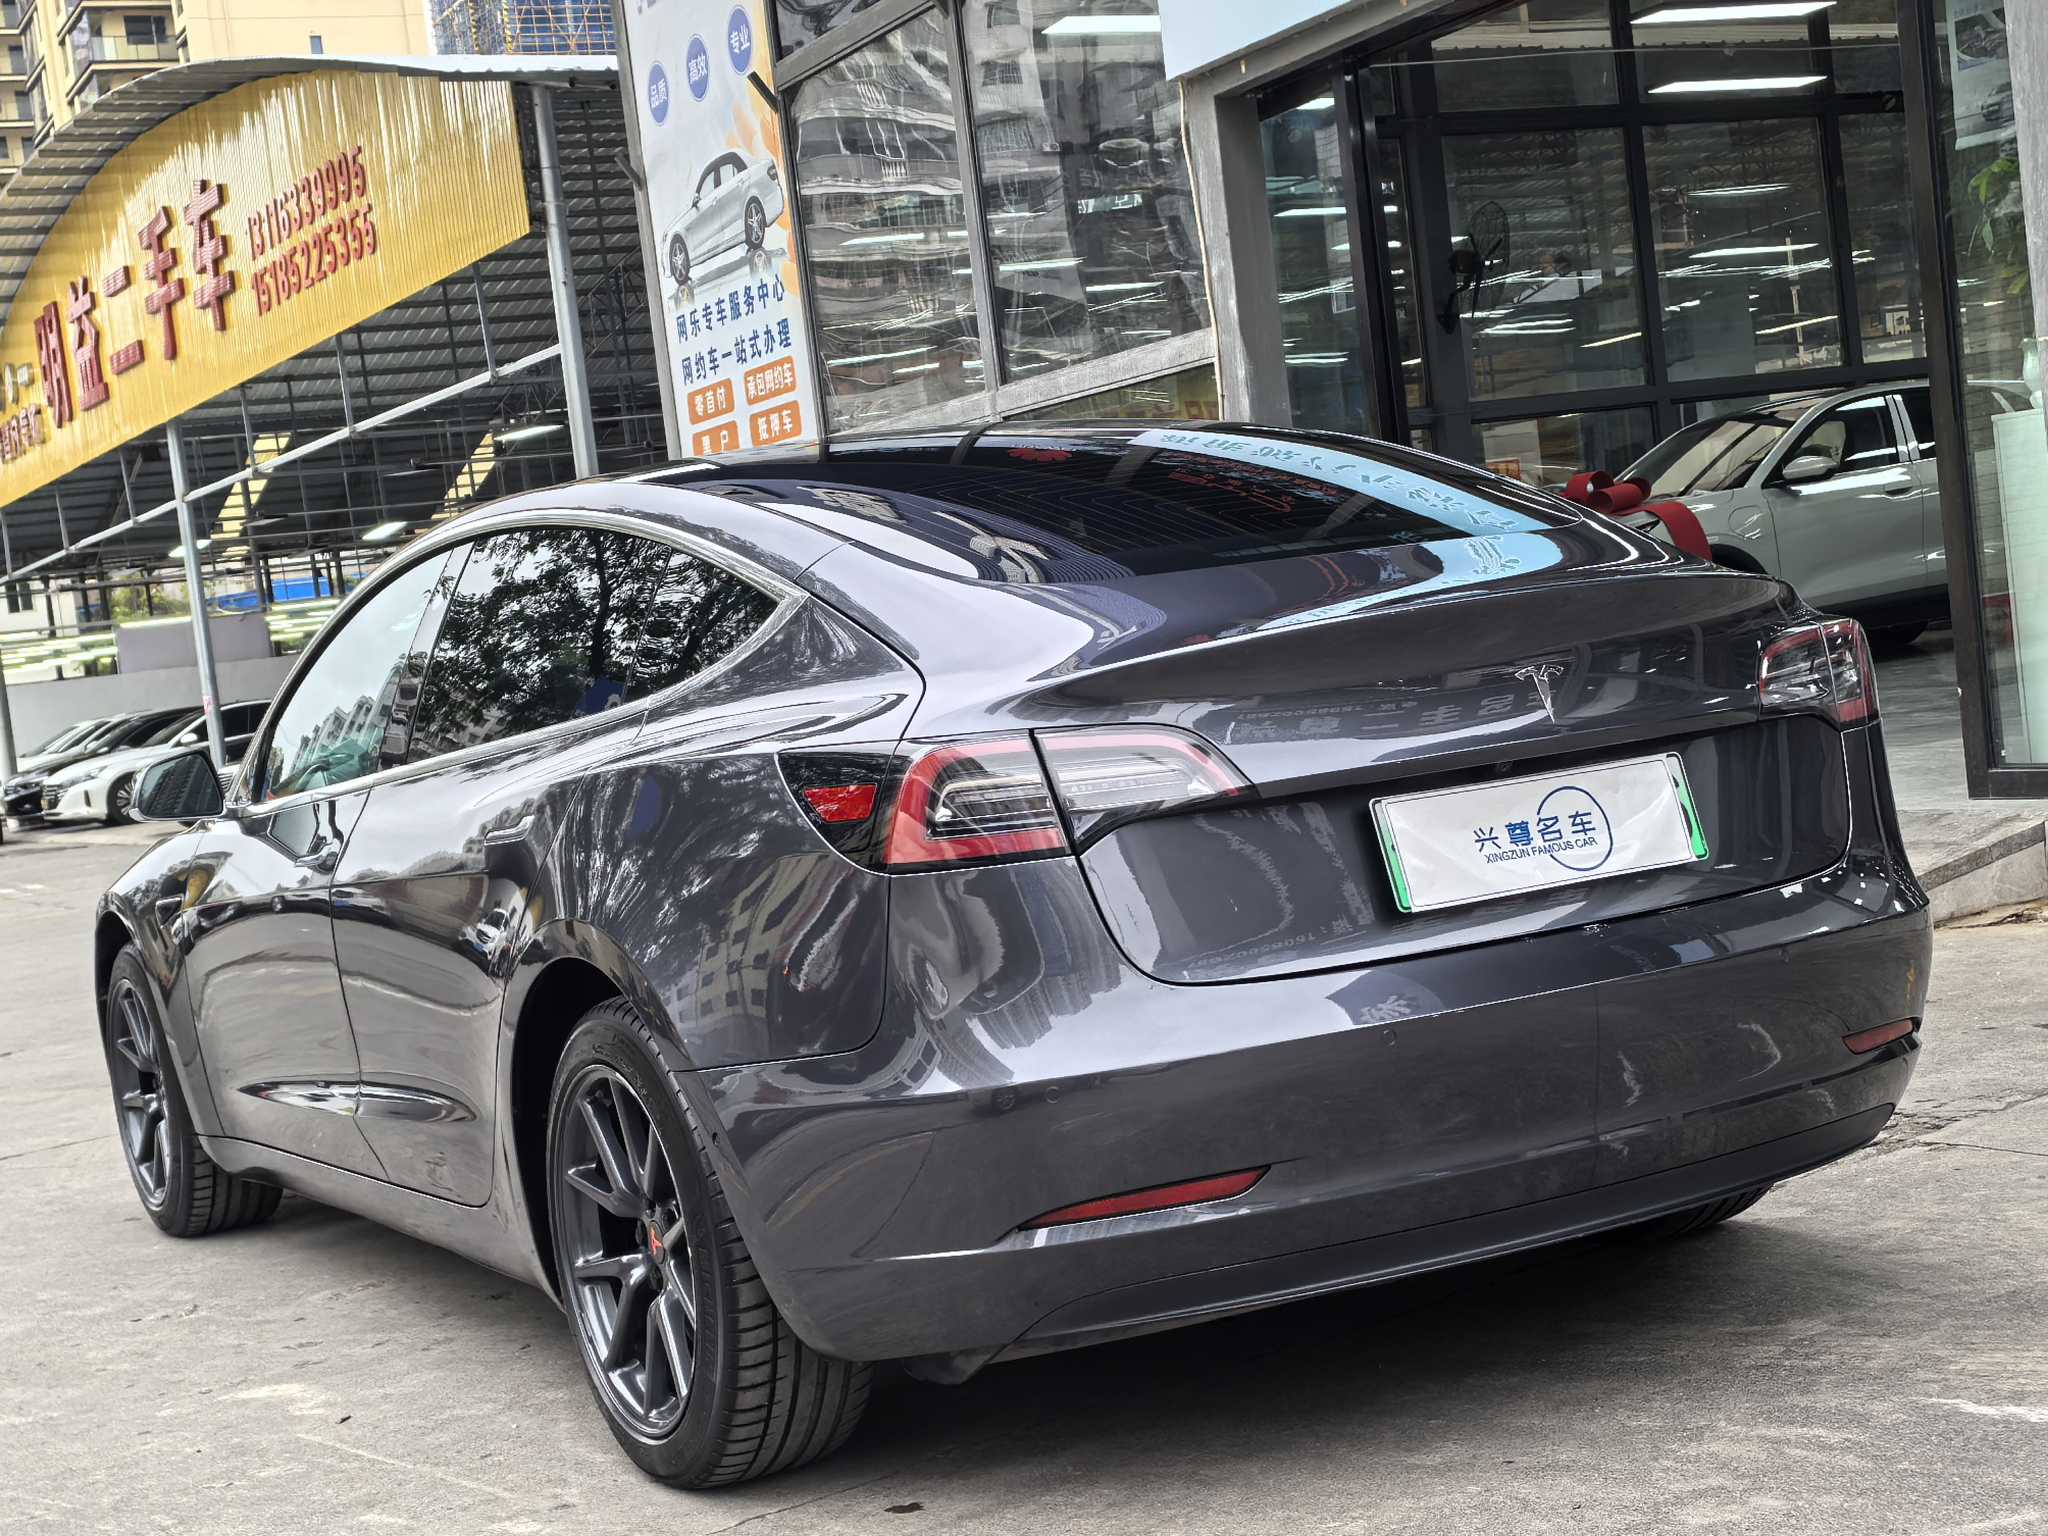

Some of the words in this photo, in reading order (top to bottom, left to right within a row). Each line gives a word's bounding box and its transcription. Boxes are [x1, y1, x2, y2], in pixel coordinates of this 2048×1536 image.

[730, 24, 750, 54] 专业
[688, 52, 707, 84] 高效
[251, 203, 377, 316] 15185225355
[681, 317, 792, 386] 网约车一站式办理
[694, 385, 726, 416] 零首付
[1473, 810, 1596, 853] 兴尊名车
[1485, 848, 1530, 864] XINGZUN
[1532, 841, 1574, 856] FAMOUS
[1575, 837, 1597, 848] CAR
